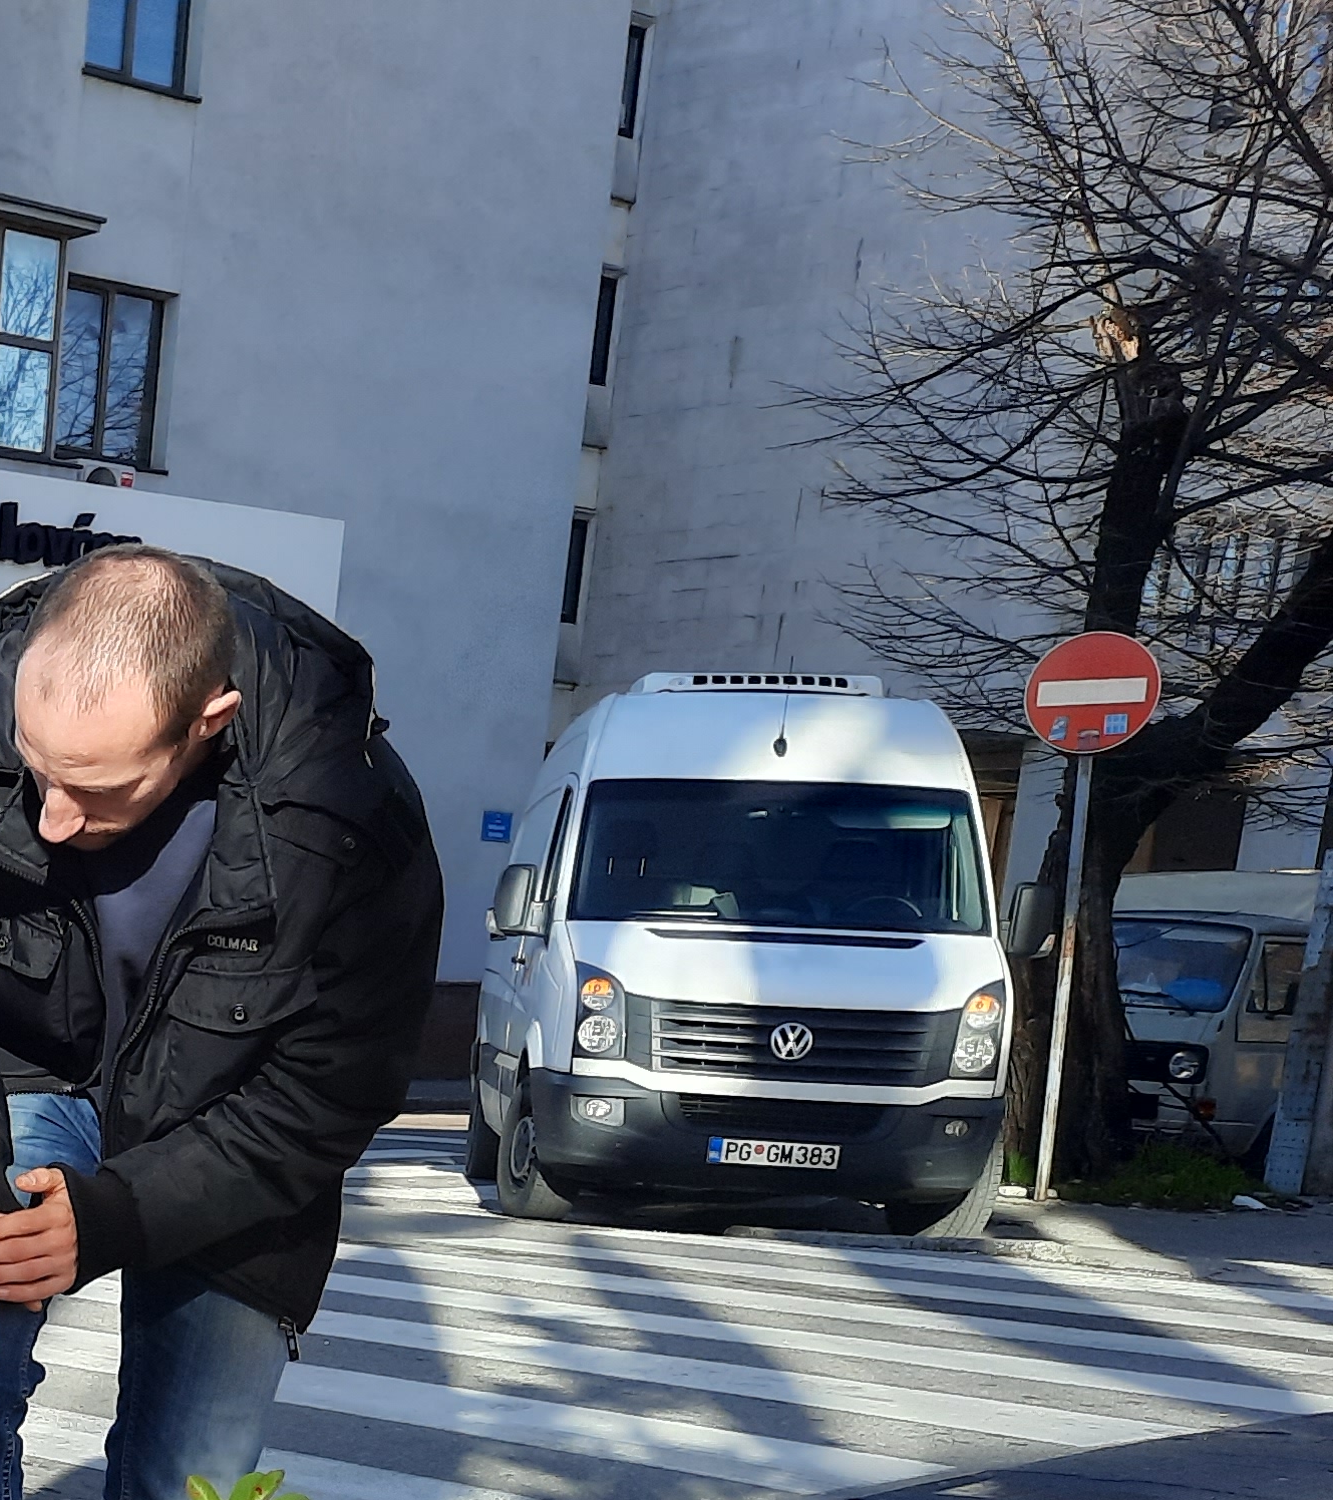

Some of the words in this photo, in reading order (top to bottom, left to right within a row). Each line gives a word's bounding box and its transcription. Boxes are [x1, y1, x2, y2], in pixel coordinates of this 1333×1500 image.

[206, 933, 259, 952] COLMAR
[725, 1141, 752, 1162] PG
[766, 1144, 837, 1167] GM383
